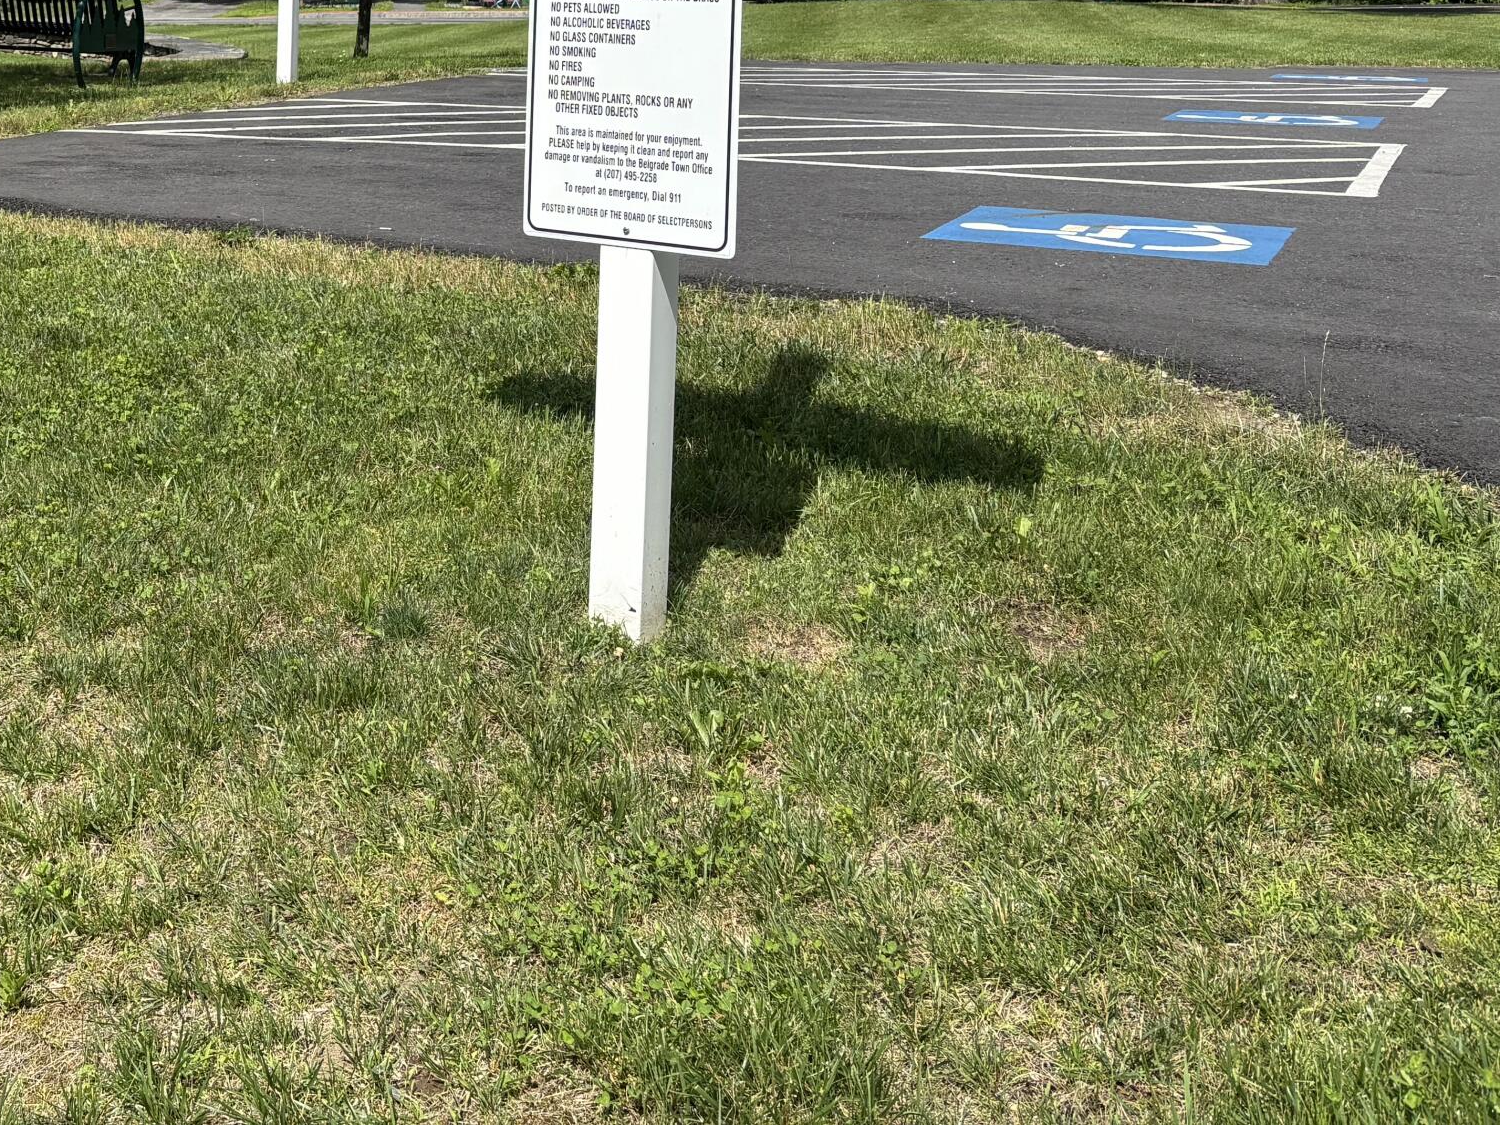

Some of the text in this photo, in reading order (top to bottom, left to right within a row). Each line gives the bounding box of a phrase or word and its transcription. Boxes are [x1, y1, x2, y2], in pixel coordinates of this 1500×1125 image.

[550, 2, 620, 14] NO PETS ALLOWED
[550, 16, 651, 31] NO ALCOHOLIC BEVERAGES
[550, 31, 636, 45] NO GLASS CONTAINERS
[549, 45, 597, 58] NO SMOKING
[549, 60, 583, 72] NO FIRES
[548, 74, 595, 88] NO CAMPING
[548, 89, 559, 100] NO
[560, 89, 600, 103] REMOVING
[635, 95, 661, 107] ROCKS
[663, 97, 675, 108] OR
[676, 97, 693, 109] ANY
[555, 102, 639, 119] OTHER FIXED OBJECTS
[556, 125, 570, 136] This
[571, 127, 586, 137] area
[588, 127, 594, 138] is
[595, 129, 633, 141] maintained
[635, 131, 645, 142] for
[646, 134, 662, 144] your
[548, 137, 709, 163] PLEASE help by keeping it clean and report any
[544, 150, 713, 175] damage or vandalism to the Belgrade Town Office
[595, 169, 602, 178] at
[564, 181, 573, 193] To
[574, 183, 596, 196] report
[597, 186, 607, 196] an
[652, 190, 667, 203] Dial
[669, 192, 682, 203] 911
[541, 202, 713, 230] POSTED BY ORDER OF THE BOARD OF SELECTPERSONS
